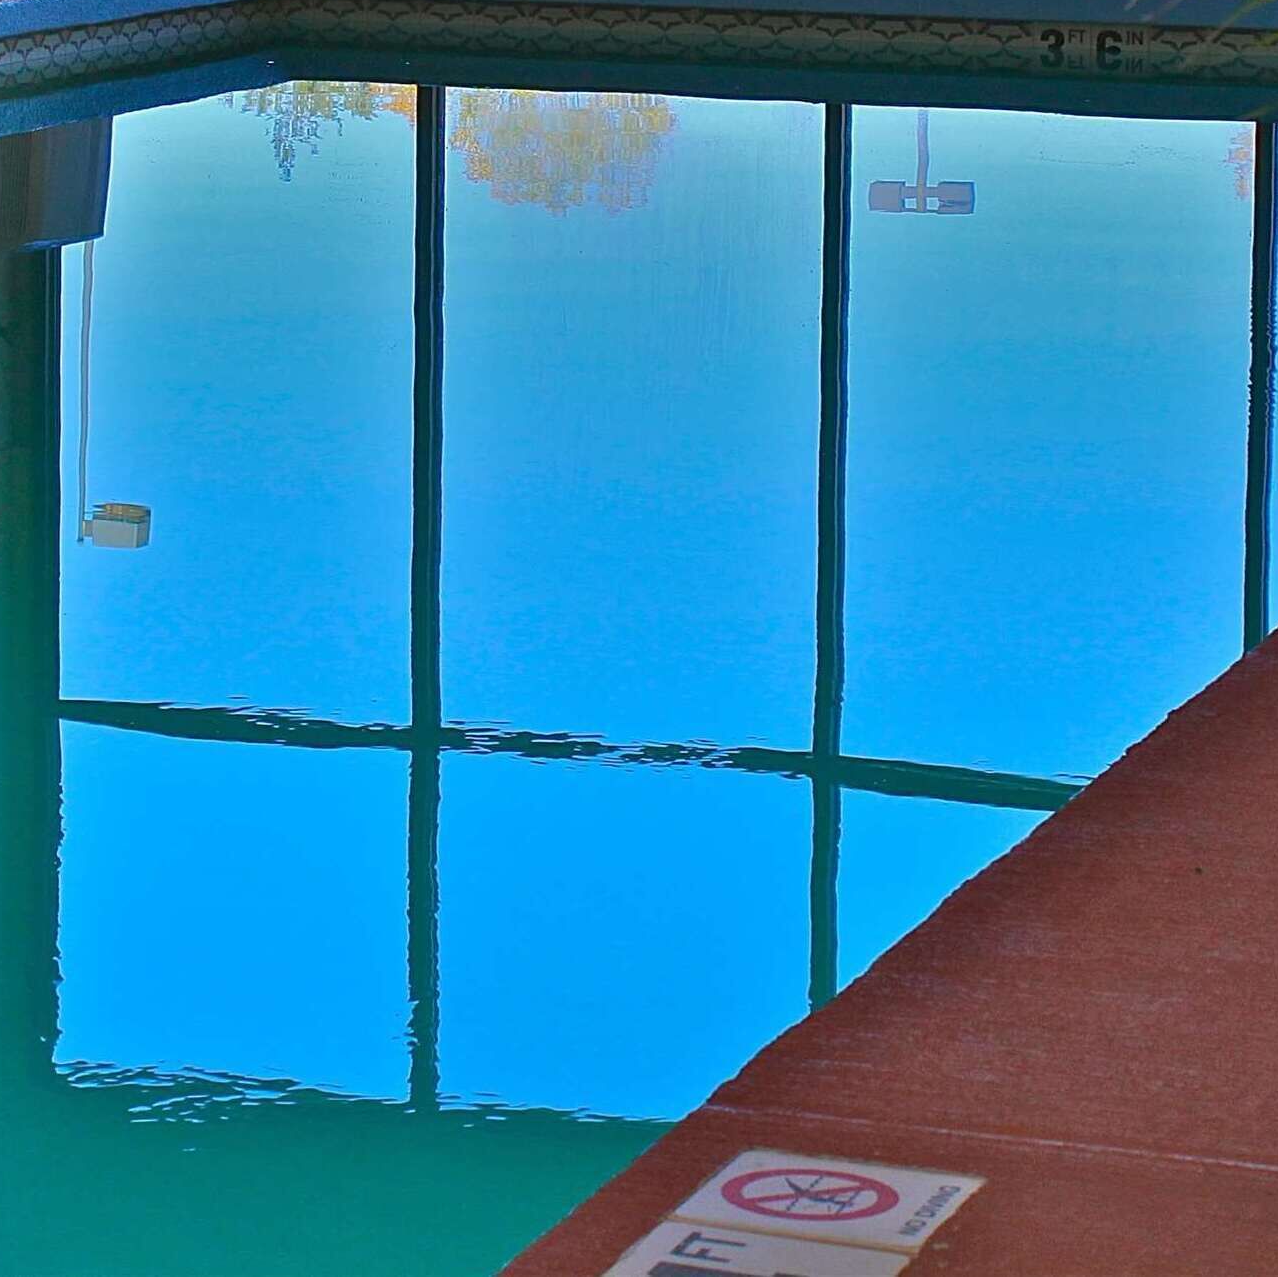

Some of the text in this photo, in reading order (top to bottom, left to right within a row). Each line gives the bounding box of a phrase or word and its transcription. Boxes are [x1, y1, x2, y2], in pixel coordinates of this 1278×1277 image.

[1068, 29, 1086, 44] FT
[1125, 31, 1144, 45] IN
[898, 1185, 961, 1236] NO DIVING
[670, 1231, 746, 1262] FT
